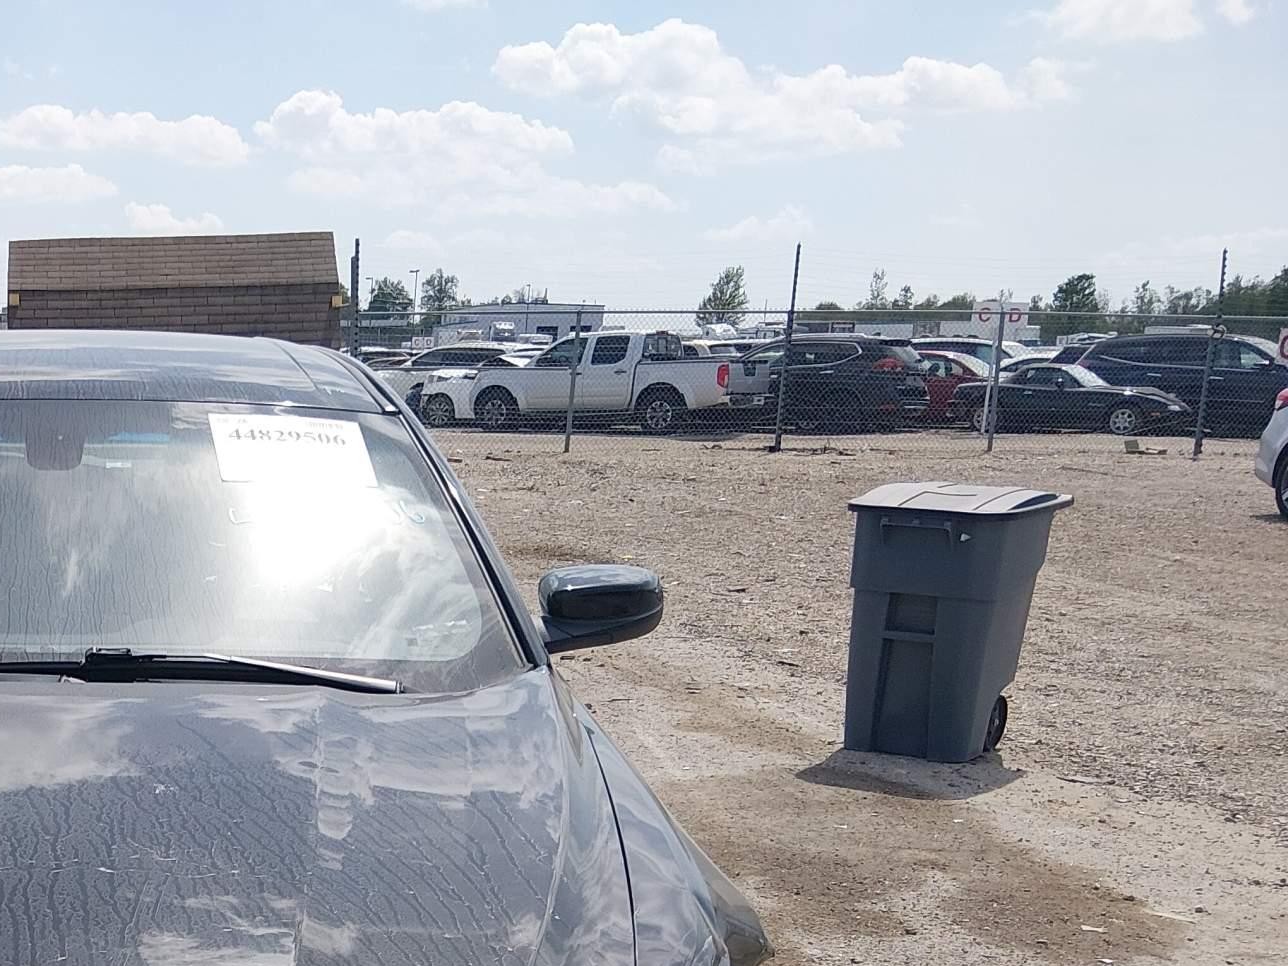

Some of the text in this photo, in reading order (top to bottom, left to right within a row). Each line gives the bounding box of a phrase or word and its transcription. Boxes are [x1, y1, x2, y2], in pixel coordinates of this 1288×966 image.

[978, 307, 1022, 323] C D
[228, 428, 346, 446] 44829506
